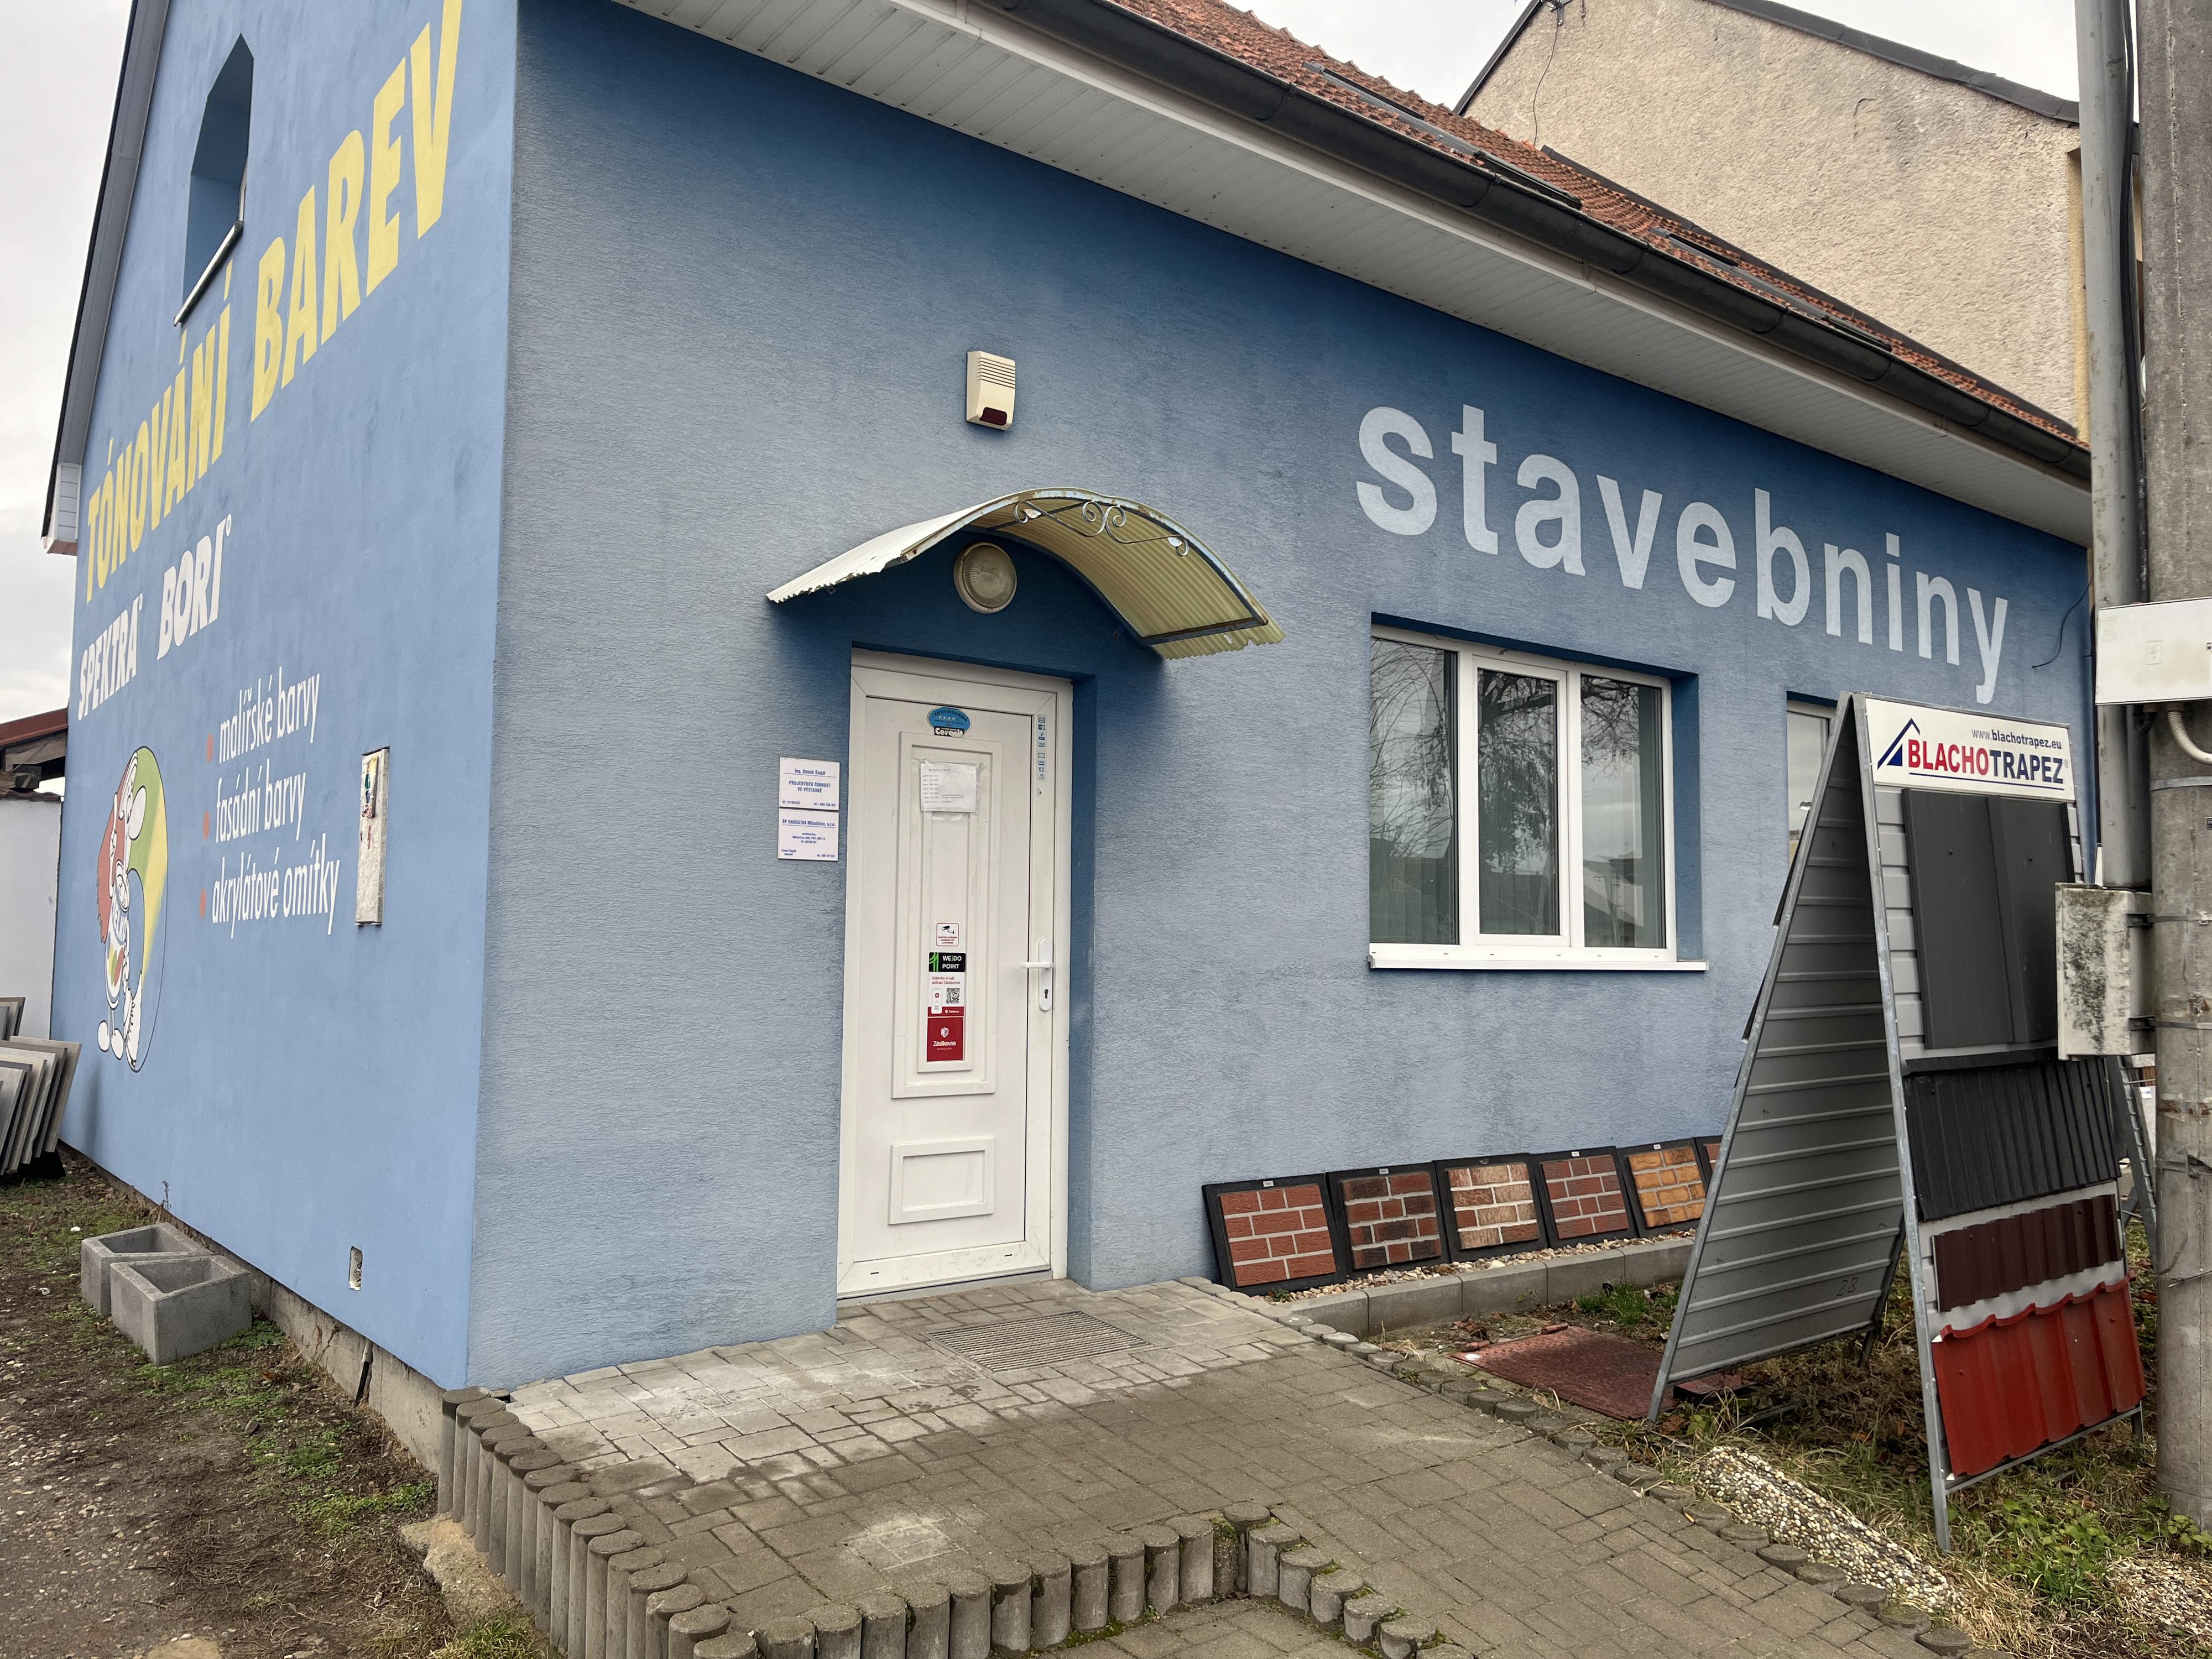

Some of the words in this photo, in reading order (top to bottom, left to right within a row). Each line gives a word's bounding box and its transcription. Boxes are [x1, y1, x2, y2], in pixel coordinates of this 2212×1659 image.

[87, 261, 233, 603] TÓNOVÁNÍ
[251, 0, 462, 422] BAREV
[1357, 404, 2008, 704] stavebniny
[219, 675, 273, 764] malířské
[276, 666, 320, 744] barvy
[1971, 728, 2062, 750] www.blachotrapez.eu
[216, 765, 263, 843] fasádní
[264, 758, 306, 841] barvy
[1908, 739, 2064, 784] BLACHOTRAPEZ
[212, 847, 280, 939] akrylátové
[283, 832, 340, 935] omítky
[1836, 1277, 1859, 1297] 28
